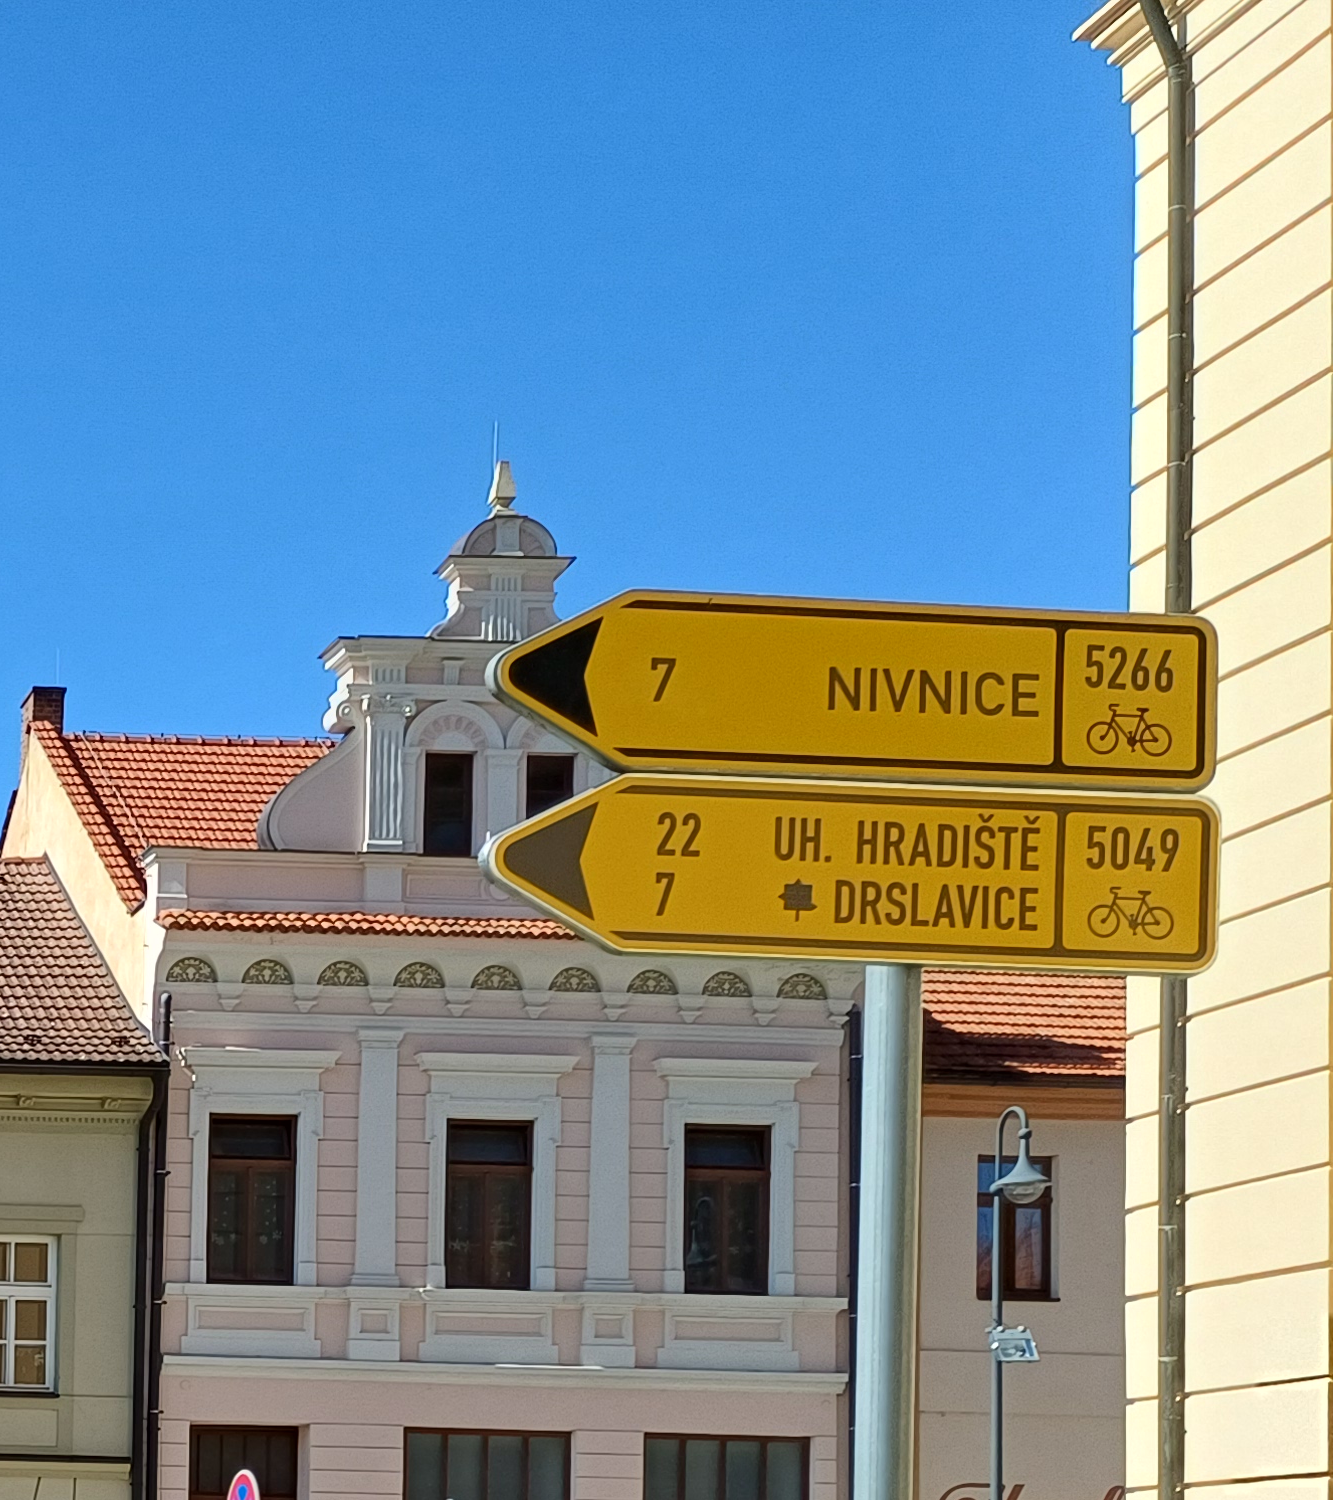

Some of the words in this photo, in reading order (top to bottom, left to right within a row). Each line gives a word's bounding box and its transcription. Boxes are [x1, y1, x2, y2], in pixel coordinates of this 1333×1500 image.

[650, 657, 677, 702] 7
[827, 665, 1040, 718] NIVNICE
[1084, 644, 1175, 693] 5266
[656, 812, 702, 858] 22
[773, 815, 832, 864] UH.
[855, 813, 1041, 872] HRADIŠTĚ
[1085, 825, 1181, 873] 5049
[654, 872, 677, 917] 7
[834, 880, 1039, 932] DRSLAVICE
